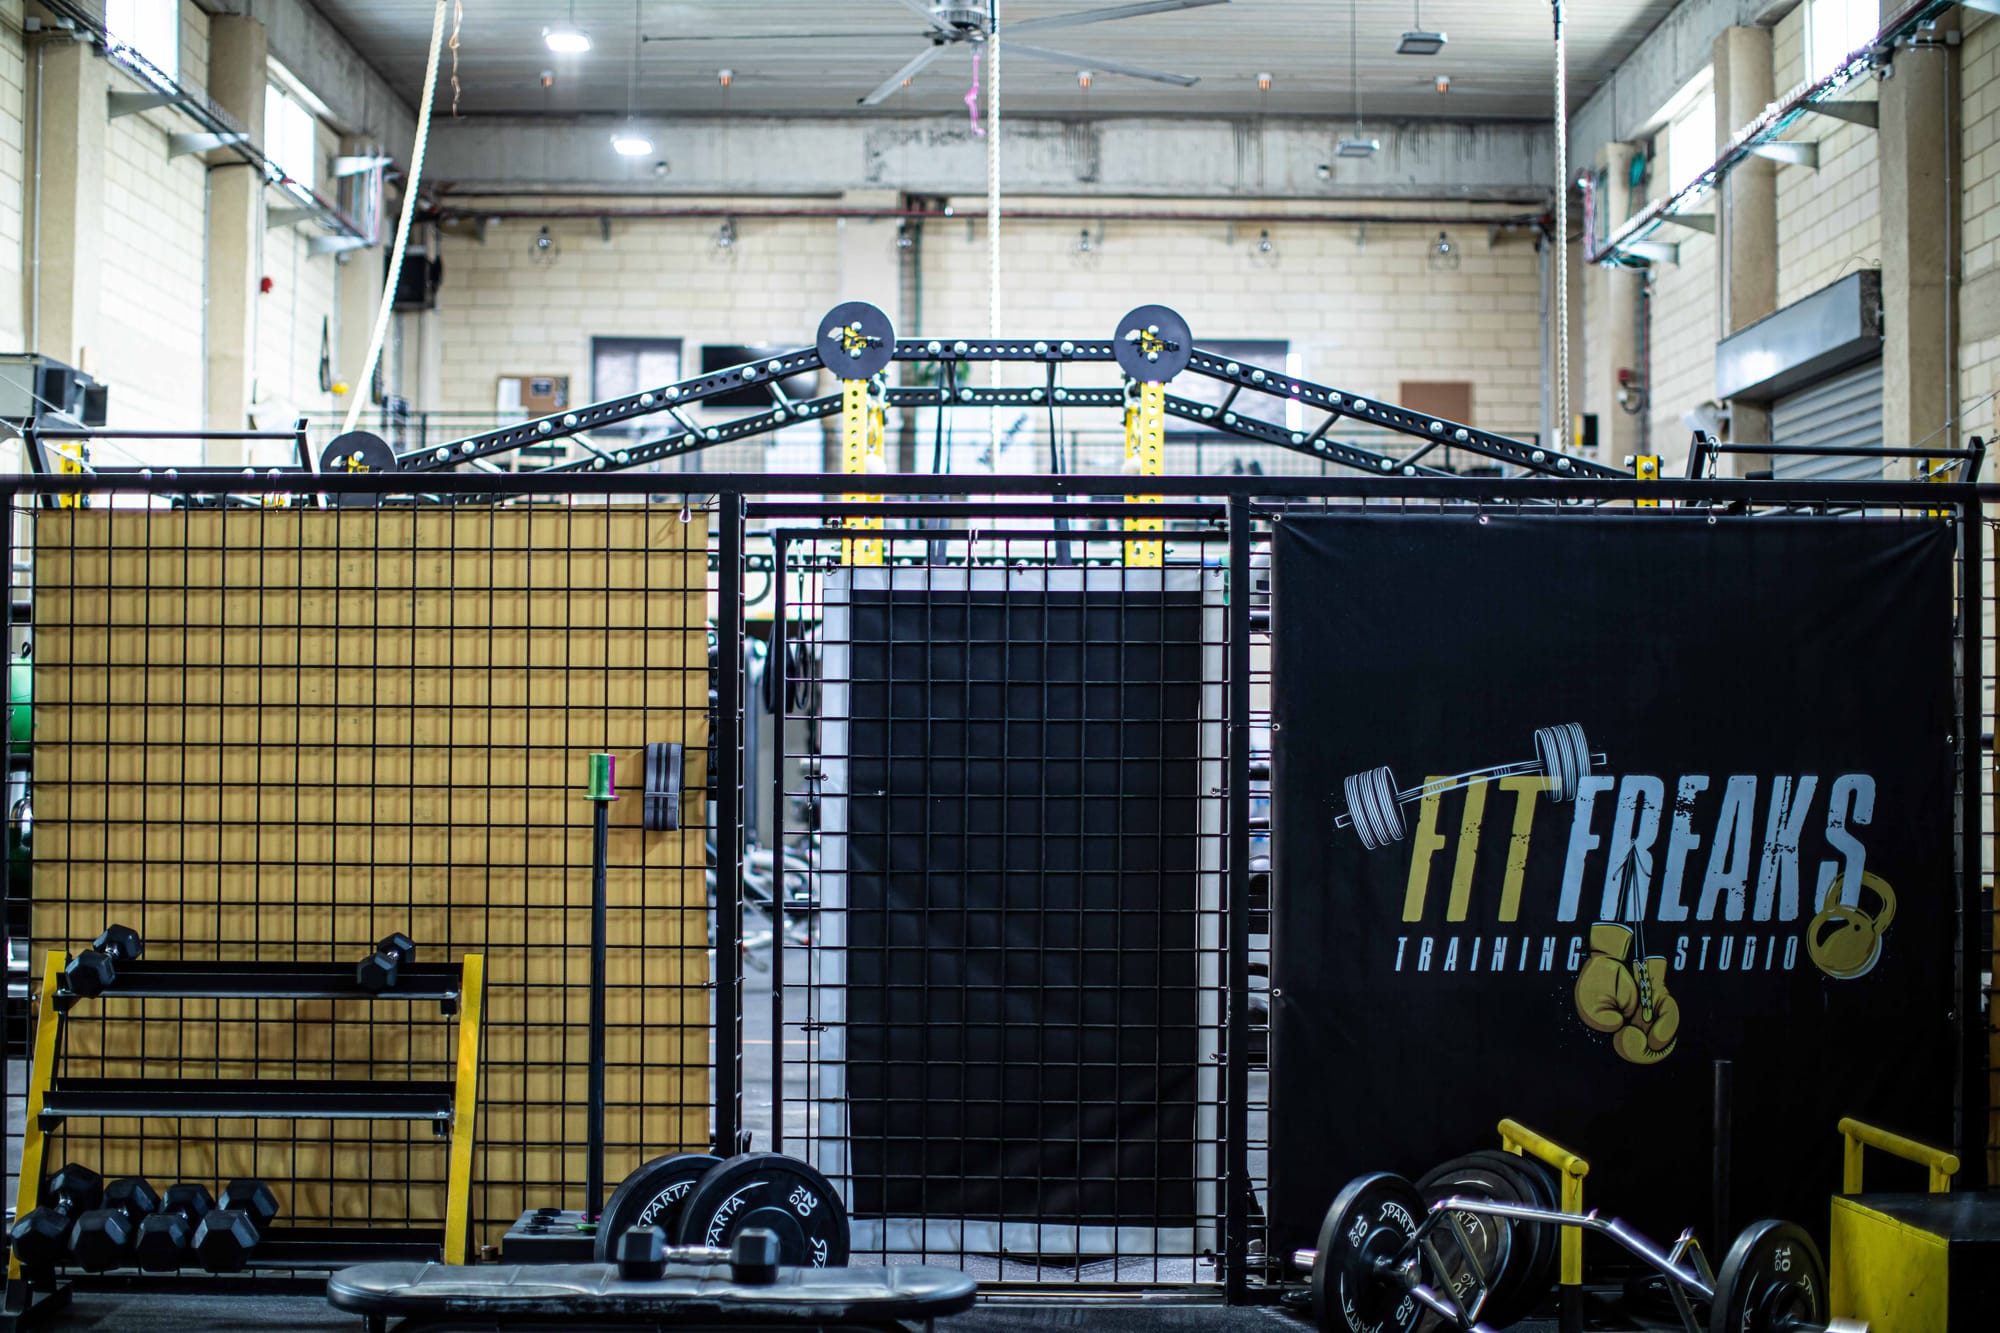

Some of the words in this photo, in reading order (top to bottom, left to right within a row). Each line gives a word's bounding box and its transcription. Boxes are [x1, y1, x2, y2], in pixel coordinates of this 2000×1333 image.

[1402, 775, 1563, 922] FIT
[1557, 774, 1876, 922] FREAKS
[1395, 936, 1583, 972] TRAINING
[1673, 935, 1799, 971] STUDIO
[639, 1182, 691, 1228] PARTA
[789, 1185, 806, 1205] KG
[797, 1191, 818, 1217] 20
[706, 1197, 746, 1250] PARTA
[1354, 1215, 1369, 1238] 10
[1347, 1229, 1361, 1248] KG
[1781, 1247, 1792, 1272] 10
